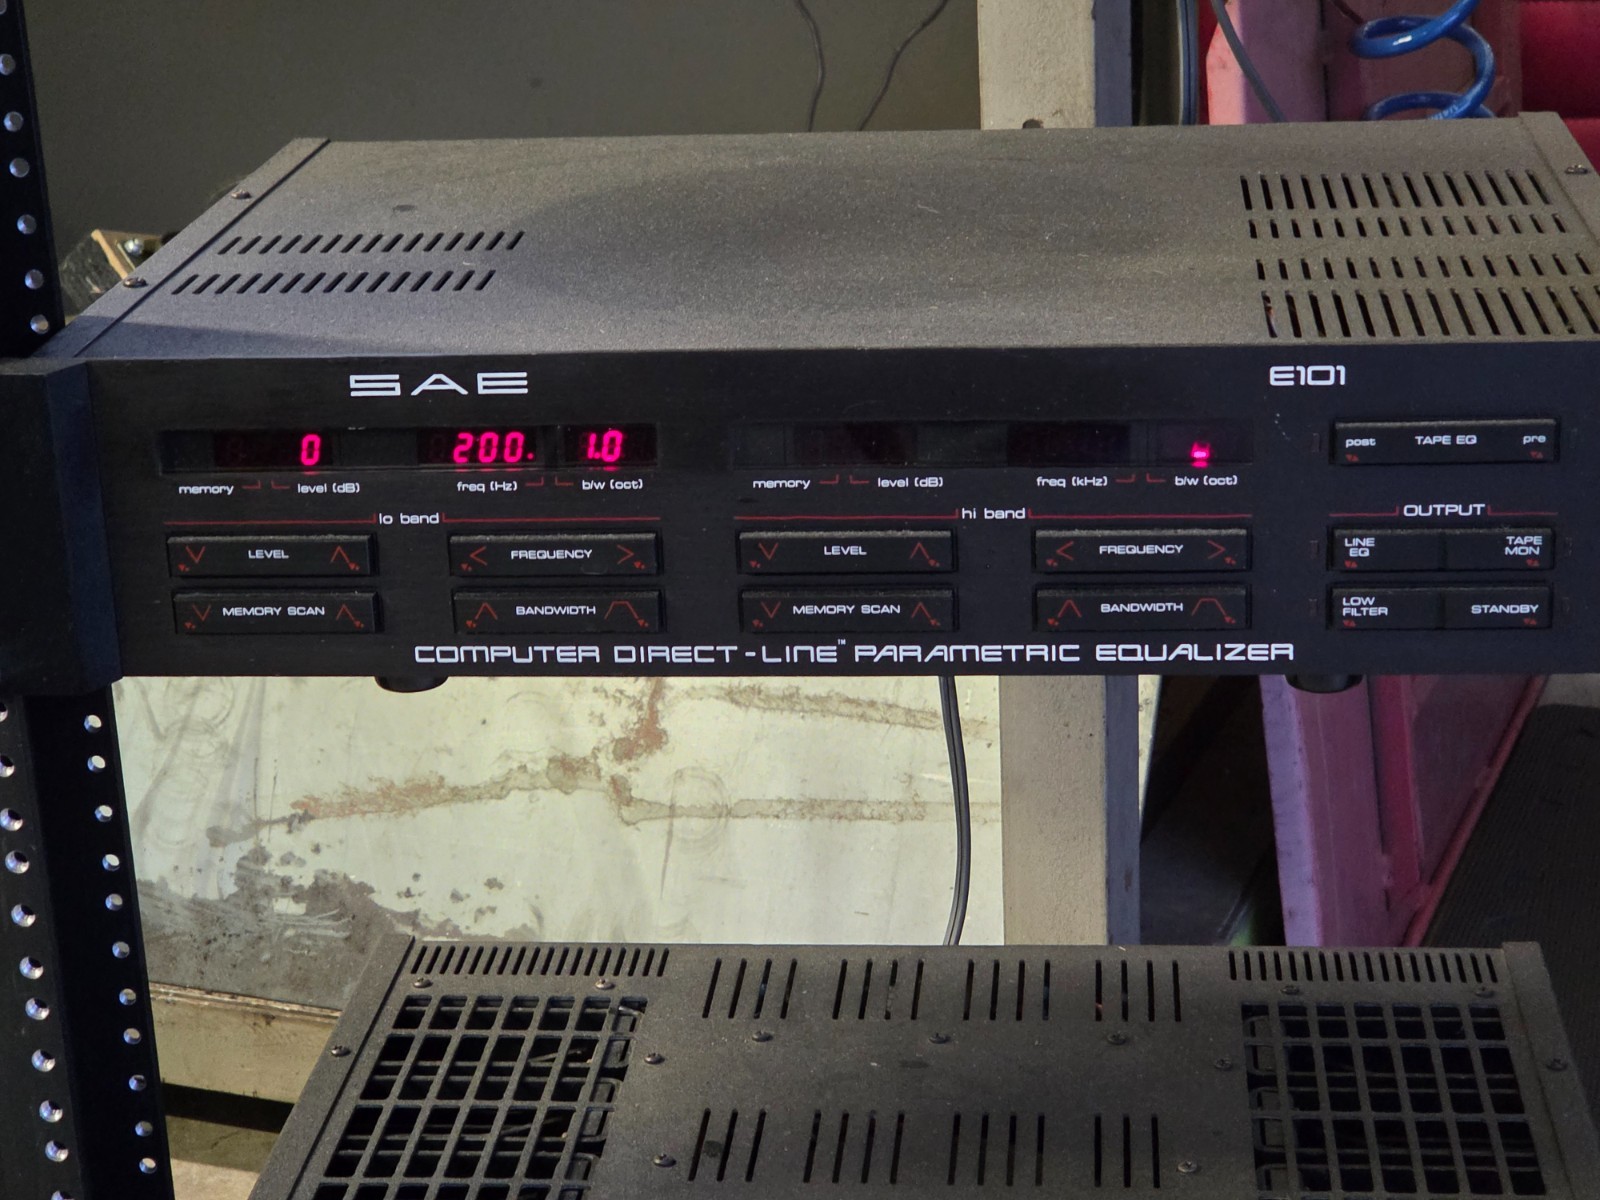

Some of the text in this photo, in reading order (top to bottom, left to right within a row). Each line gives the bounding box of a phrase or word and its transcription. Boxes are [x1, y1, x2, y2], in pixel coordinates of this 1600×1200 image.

[1269, 365, 1346, 387] E101
[349, 371, 529, 397] SAE
[1345, 437, 1377, 449] post
[1414, 434, 1478, 445] TAPE EQ
[1522, 435, 1547, 445] pre
[300, 434, 321, 466] 0
[587, 429, 623, 463] 1.0
[581, 478, 644, 491] b/w (oct)
[752, 479, 811, 490] memory
[877, 476, 944, 488] level (dB)
[1036, 475, 1108, 489] freq (kHz)
[1174, 474, 1238, 486] b/w (oct)
[178, 485, 235, 496] memory
[297, 482, 361, 494] level (dB)
[456, 480, 518, 494] freq (Hz)
[961, 507, 1026, 520] hi band
[1403, 503, 1486, 517] OUTPUT
[378, 512, 440, 525] lo band
[1345, 538, 1375, 547] LINE
[1506, 536, 1543, 546] TAPE
[247, 549, 290, 559] LEVEL
[510, 549, 593, 560] FREQUENCY
[823, 545, 867, 556] LEVEL
[1098, 544, 1184, 555] FREQUENCY
[1349, 548, 1370, 557] EQ
[1504, 546, 1540, 556] MON
[1342, 597, 1376, 606] LOW
[222, 606, 326, 617] MEMORY SCAN
[515, 605, 597, 616] BANDWIDTH
[792, 604, 901, 615] MEMORY SCAN
[1100, 602, 1184, 613] BANDWIDTH
[1342, 606, 1389, 617] FILTER
[1471, 604, 1539, 615] STANDBY
[414, 645, 601, 664] COMPUTER
[854, 644, 1081, 663] PARAMETRIC
[1095, 643, 1294, 662] EQUALIZER
